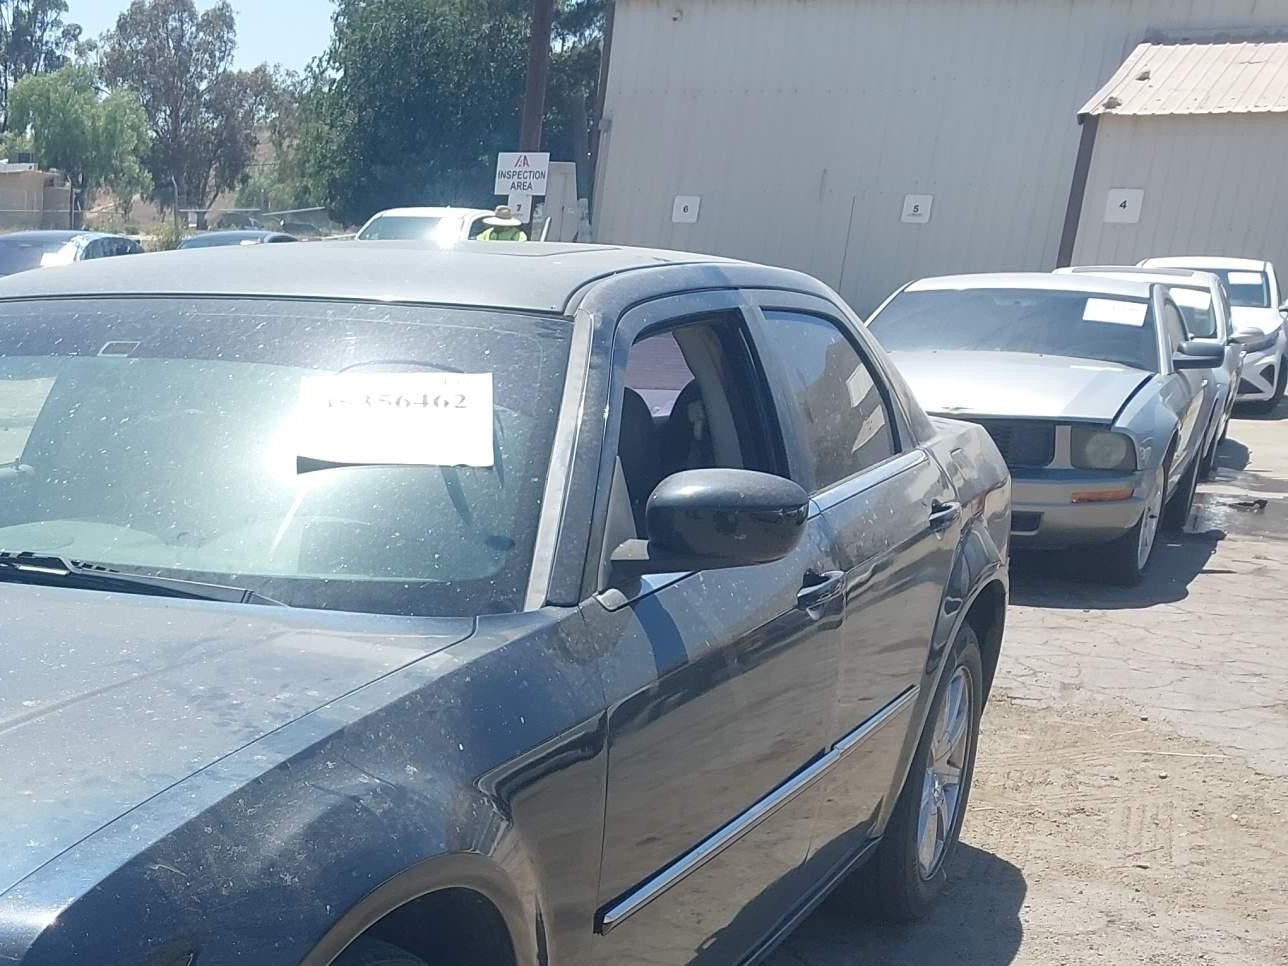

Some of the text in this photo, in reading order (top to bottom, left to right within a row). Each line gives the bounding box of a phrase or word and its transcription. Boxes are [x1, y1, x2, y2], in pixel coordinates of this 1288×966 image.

[497, 170, 547, 180] INSPECTION
[510, 181, 533, 191] AREA
[516, 204, 522, 212] 7
[682, 204, 689, 213] 6
[913, 204, 920, 213] 5
[1119, 199, 1127, 209] 4
